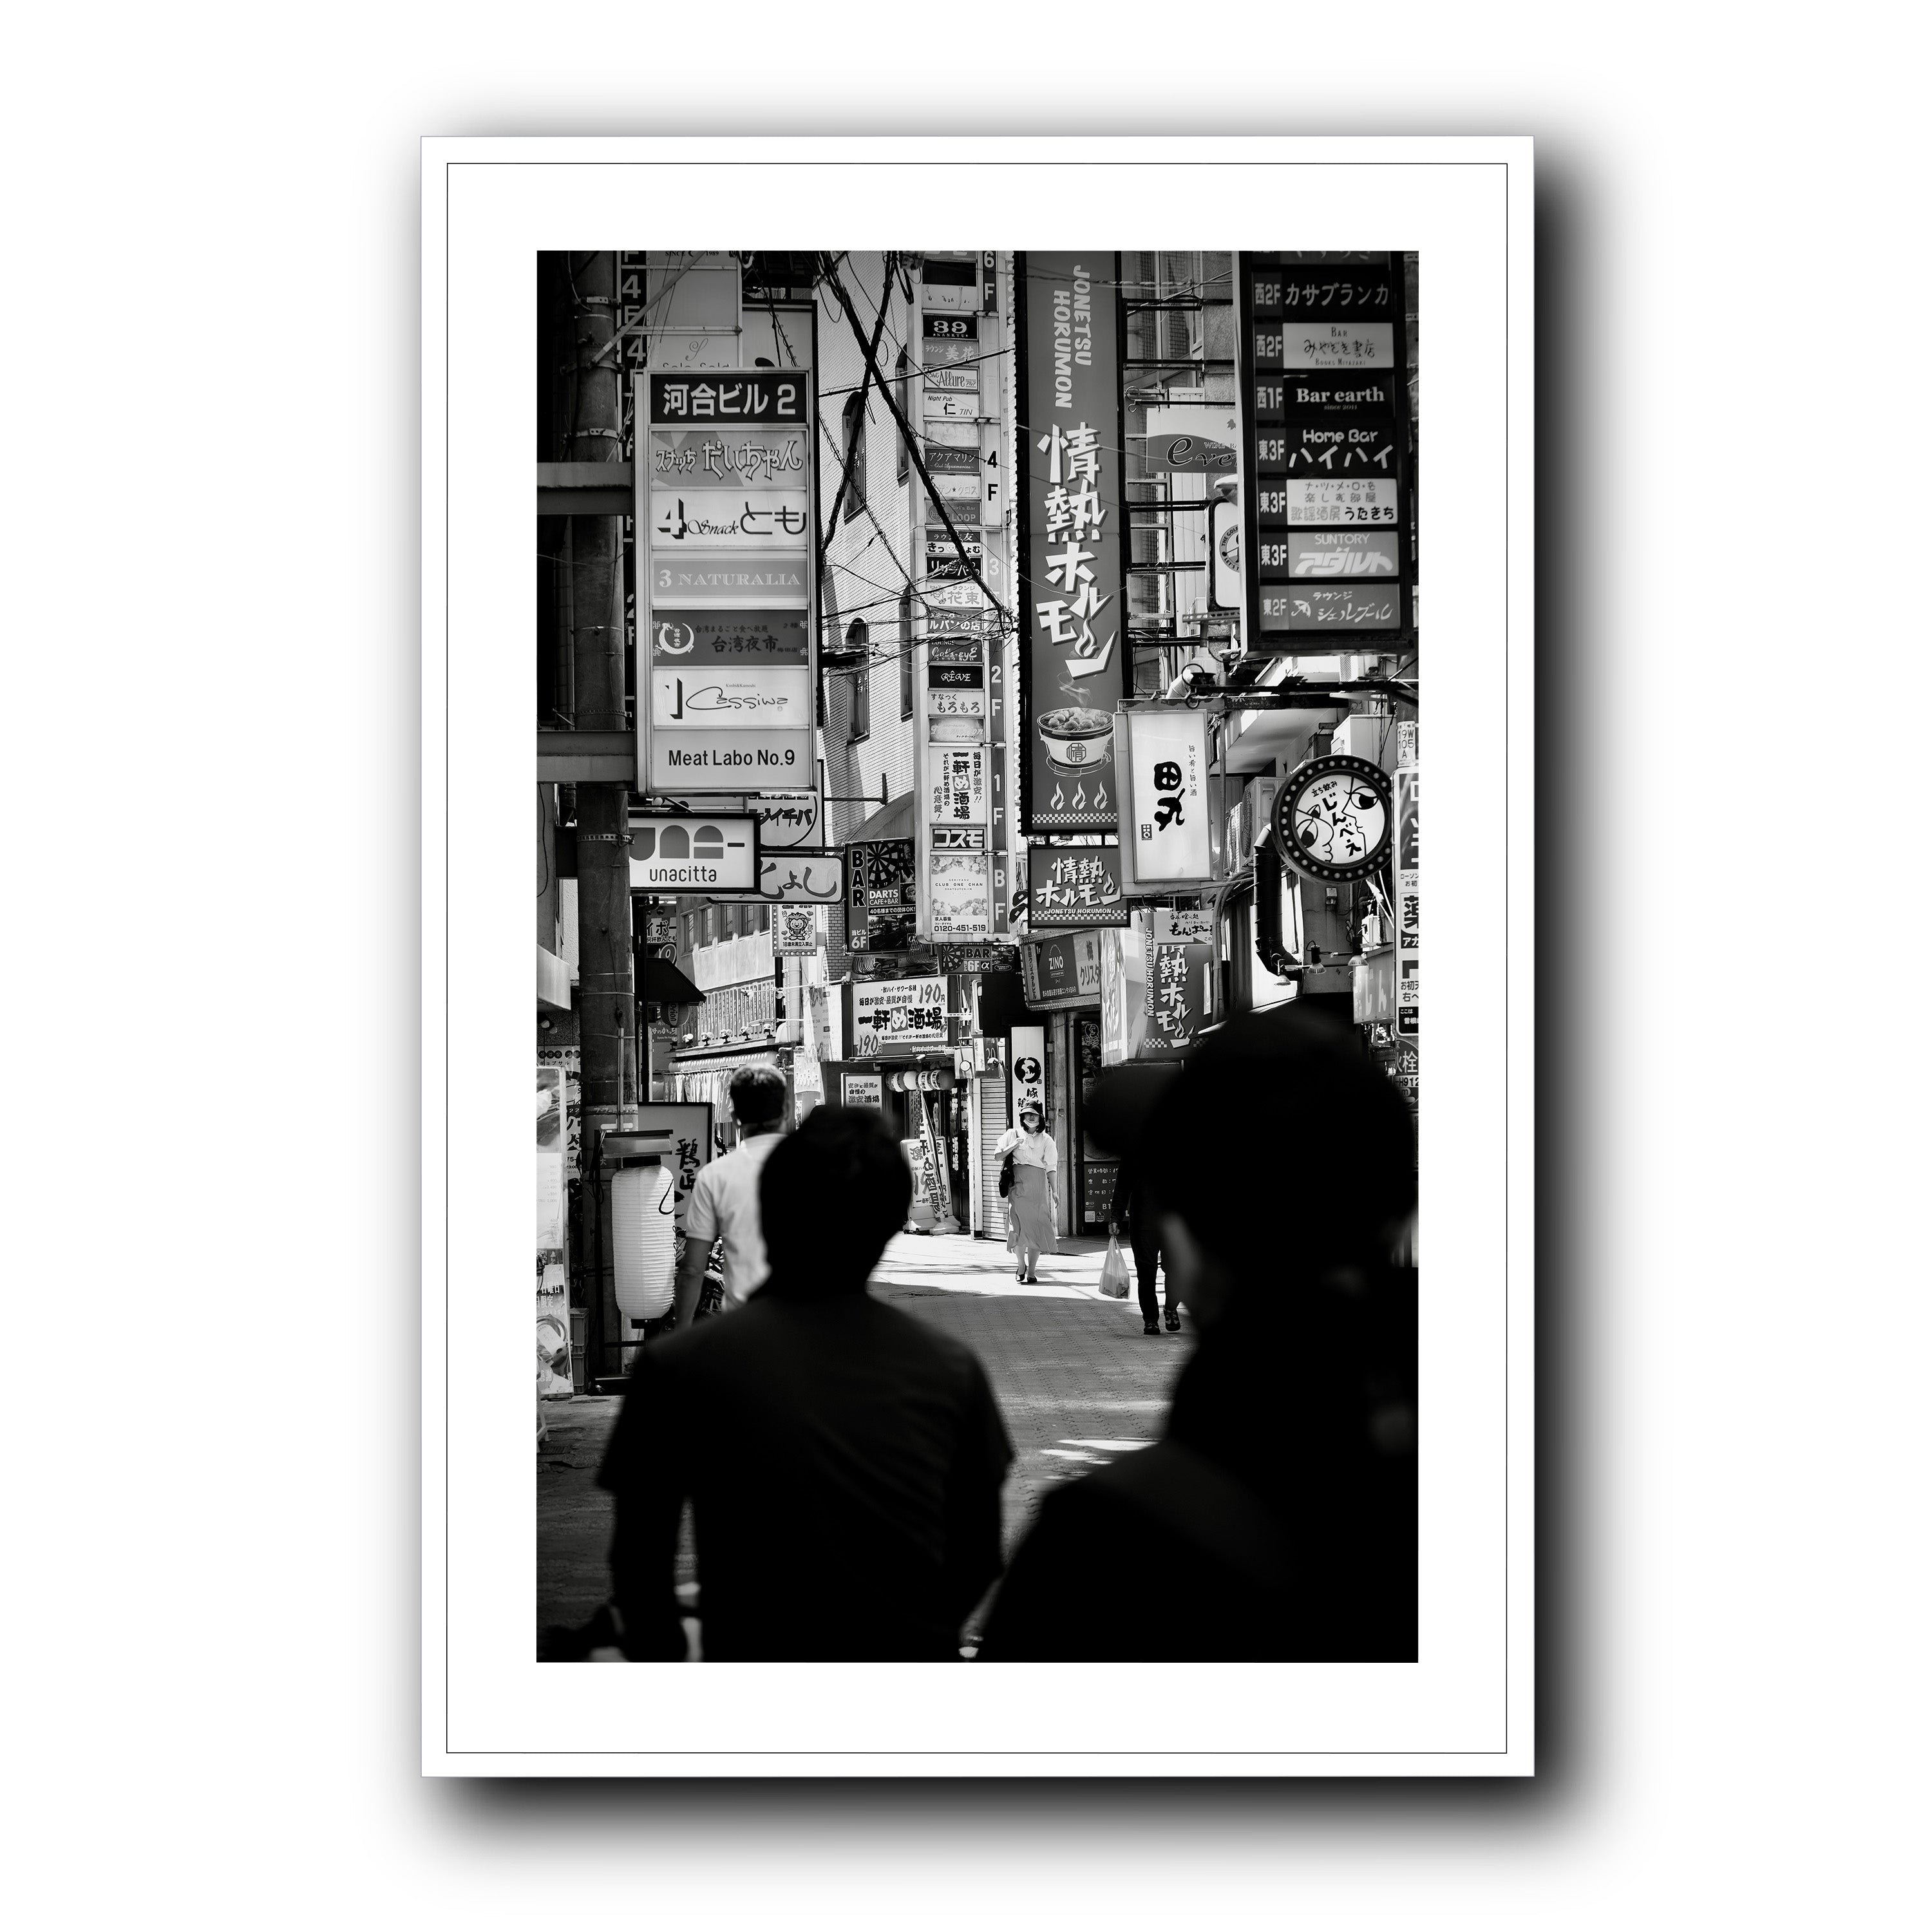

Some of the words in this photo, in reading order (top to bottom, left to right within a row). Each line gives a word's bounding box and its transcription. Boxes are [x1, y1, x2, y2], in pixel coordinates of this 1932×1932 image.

[1285, 282, 1389, 307] カサブランカ
[1073, 265, 1092, 366] JONETSU
[934, 321, 967, 334] 39
[1053, 290, 1072, 408] HORUMON
[937, 370, 965, 388] Allure
[663, 383, 769, 416] 河合ビル
[777, 384, 797, 415] 2
[1296, 388, 1331, 402] Bar
[1334, 386, 1385, 402] earth
[1302, 429, 1345, 443] Home
[1348, 428, 1379, 443] Bar
[701, 439, 803, 481] だいちゃん
[929, 452, 976, 463] アクアマリン
[1258, 439, 1285, 461] 東3F
[1289, 444, 1394, 470] ハイハイ
[1259, 491, 1286, 513] 東3F
[1345, 506, 1394, 520] うたきち
[687, 519, 739, 536] Snack
[1314, 533, 1370, 545] SUNTORY
[1037, 421, 1119, 681] 情熱ホルモン
[1260, 544, 1287, 566] 東3F
[658, 569, 672, 588] 3
[677, 573, 802, 586] NATURALIA
[947, 591, 981, 605] 花束
[1312, 591, 1353, 601] ラウンジ
[1262, 598, 1287, 616] 東2F
[711, 634, 779, 653] 台湾夜市
[990, 665, 1002, 717] 2F
[936, 701, 981, 714] もろもろ
[1398, 739, 1415, 750] 105
[668, 750, 708, 766] Meat
[713, 750, 753, 766] Labo
[757, 749, 795, 766] No.9
[1401, 750, 1408, 759] A
[952, 752, 971, 820] 一軒め酒場
[1311, 780, 1338, 798] 立ち飲み
[993, 773, 1004, 825] 1F
[1321, 791, 1363, 857] じんべえ
[934, 829, 983, 848] コスモ
[649, 866, 717, 882] unacitta
[851, 849, 867, 908] BAR
[1050, 855, 1106, 886] 情熱
[869, 889, 899, 899] DARTS
[1035, 879, 1121, 907] ホルモン
[934, 924, 987, 933] 0120-451-519
[851, 936, 867, 949] 6F
[965, 947, 991, 959] BAR
[967, 960, 980, 972] 6F
[1048, 955, 1064, 971] ZINO
[858, 1005, 943, 1033] 一軒め酒場
